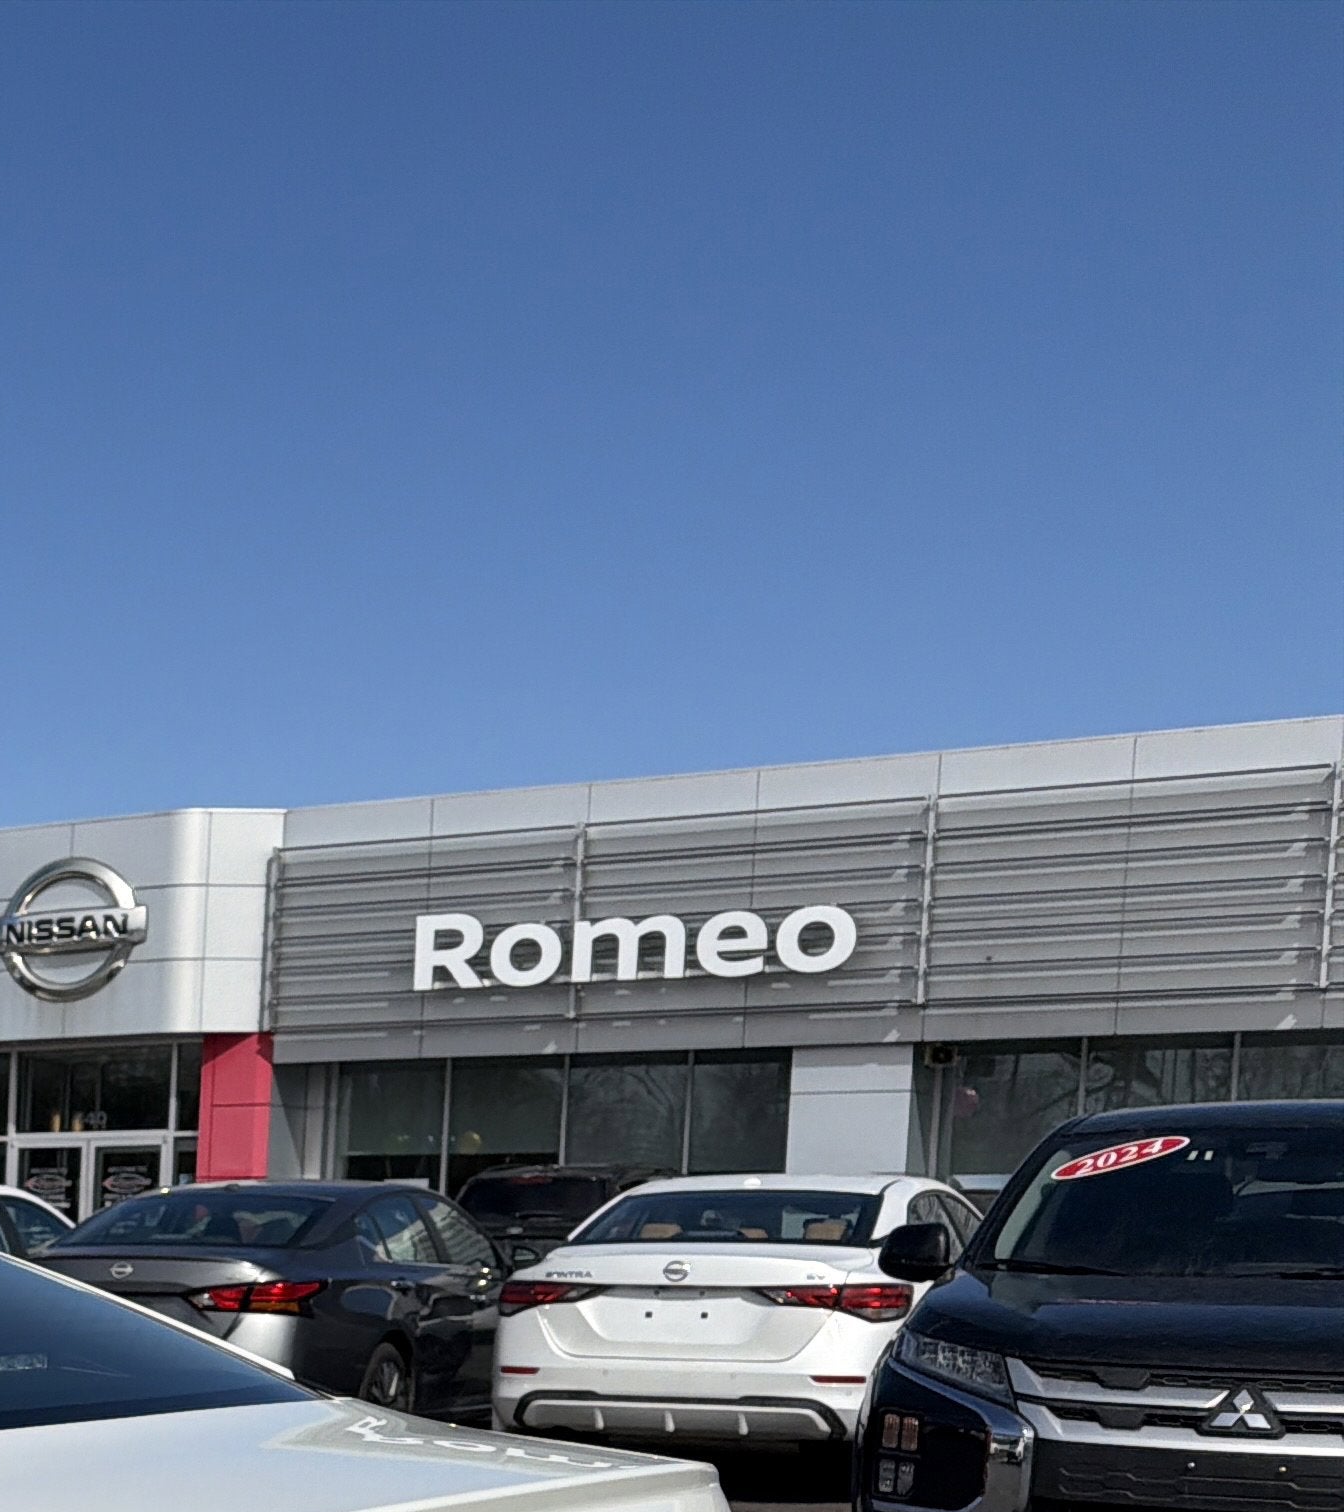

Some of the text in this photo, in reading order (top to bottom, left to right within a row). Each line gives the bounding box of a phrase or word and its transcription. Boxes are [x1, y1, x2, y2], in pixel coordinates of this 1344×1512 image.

[6, 913, 129, 946] NISSAN
[413, 905, 857, 991] Romeo
[1075, 1139, 1162, 1175] 2024
